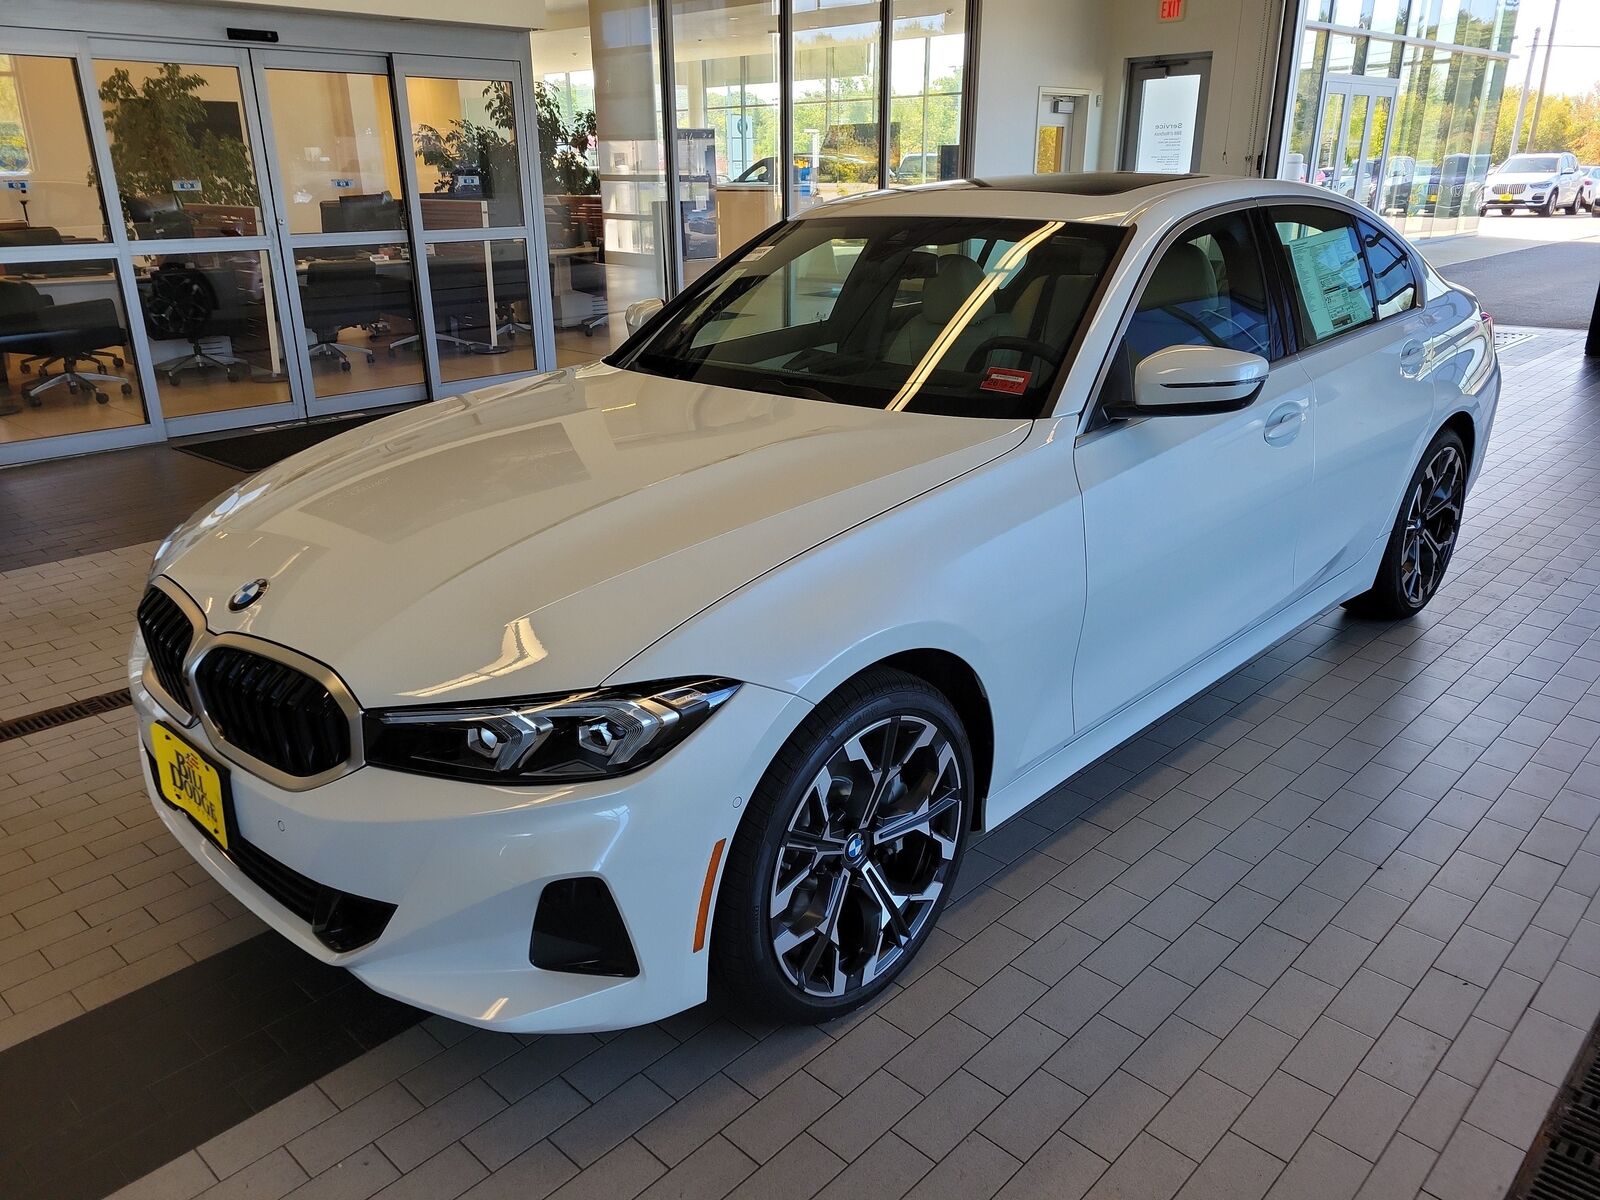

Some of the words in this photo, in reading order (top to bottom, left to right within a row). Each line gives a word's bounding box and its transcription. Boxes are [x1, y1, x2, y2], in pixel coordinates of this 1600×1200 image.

[1160, 0, 1182, 18] EXIT
[168, 761, 218, 822] DODGE
[175, 749, 207, 797] BILL
